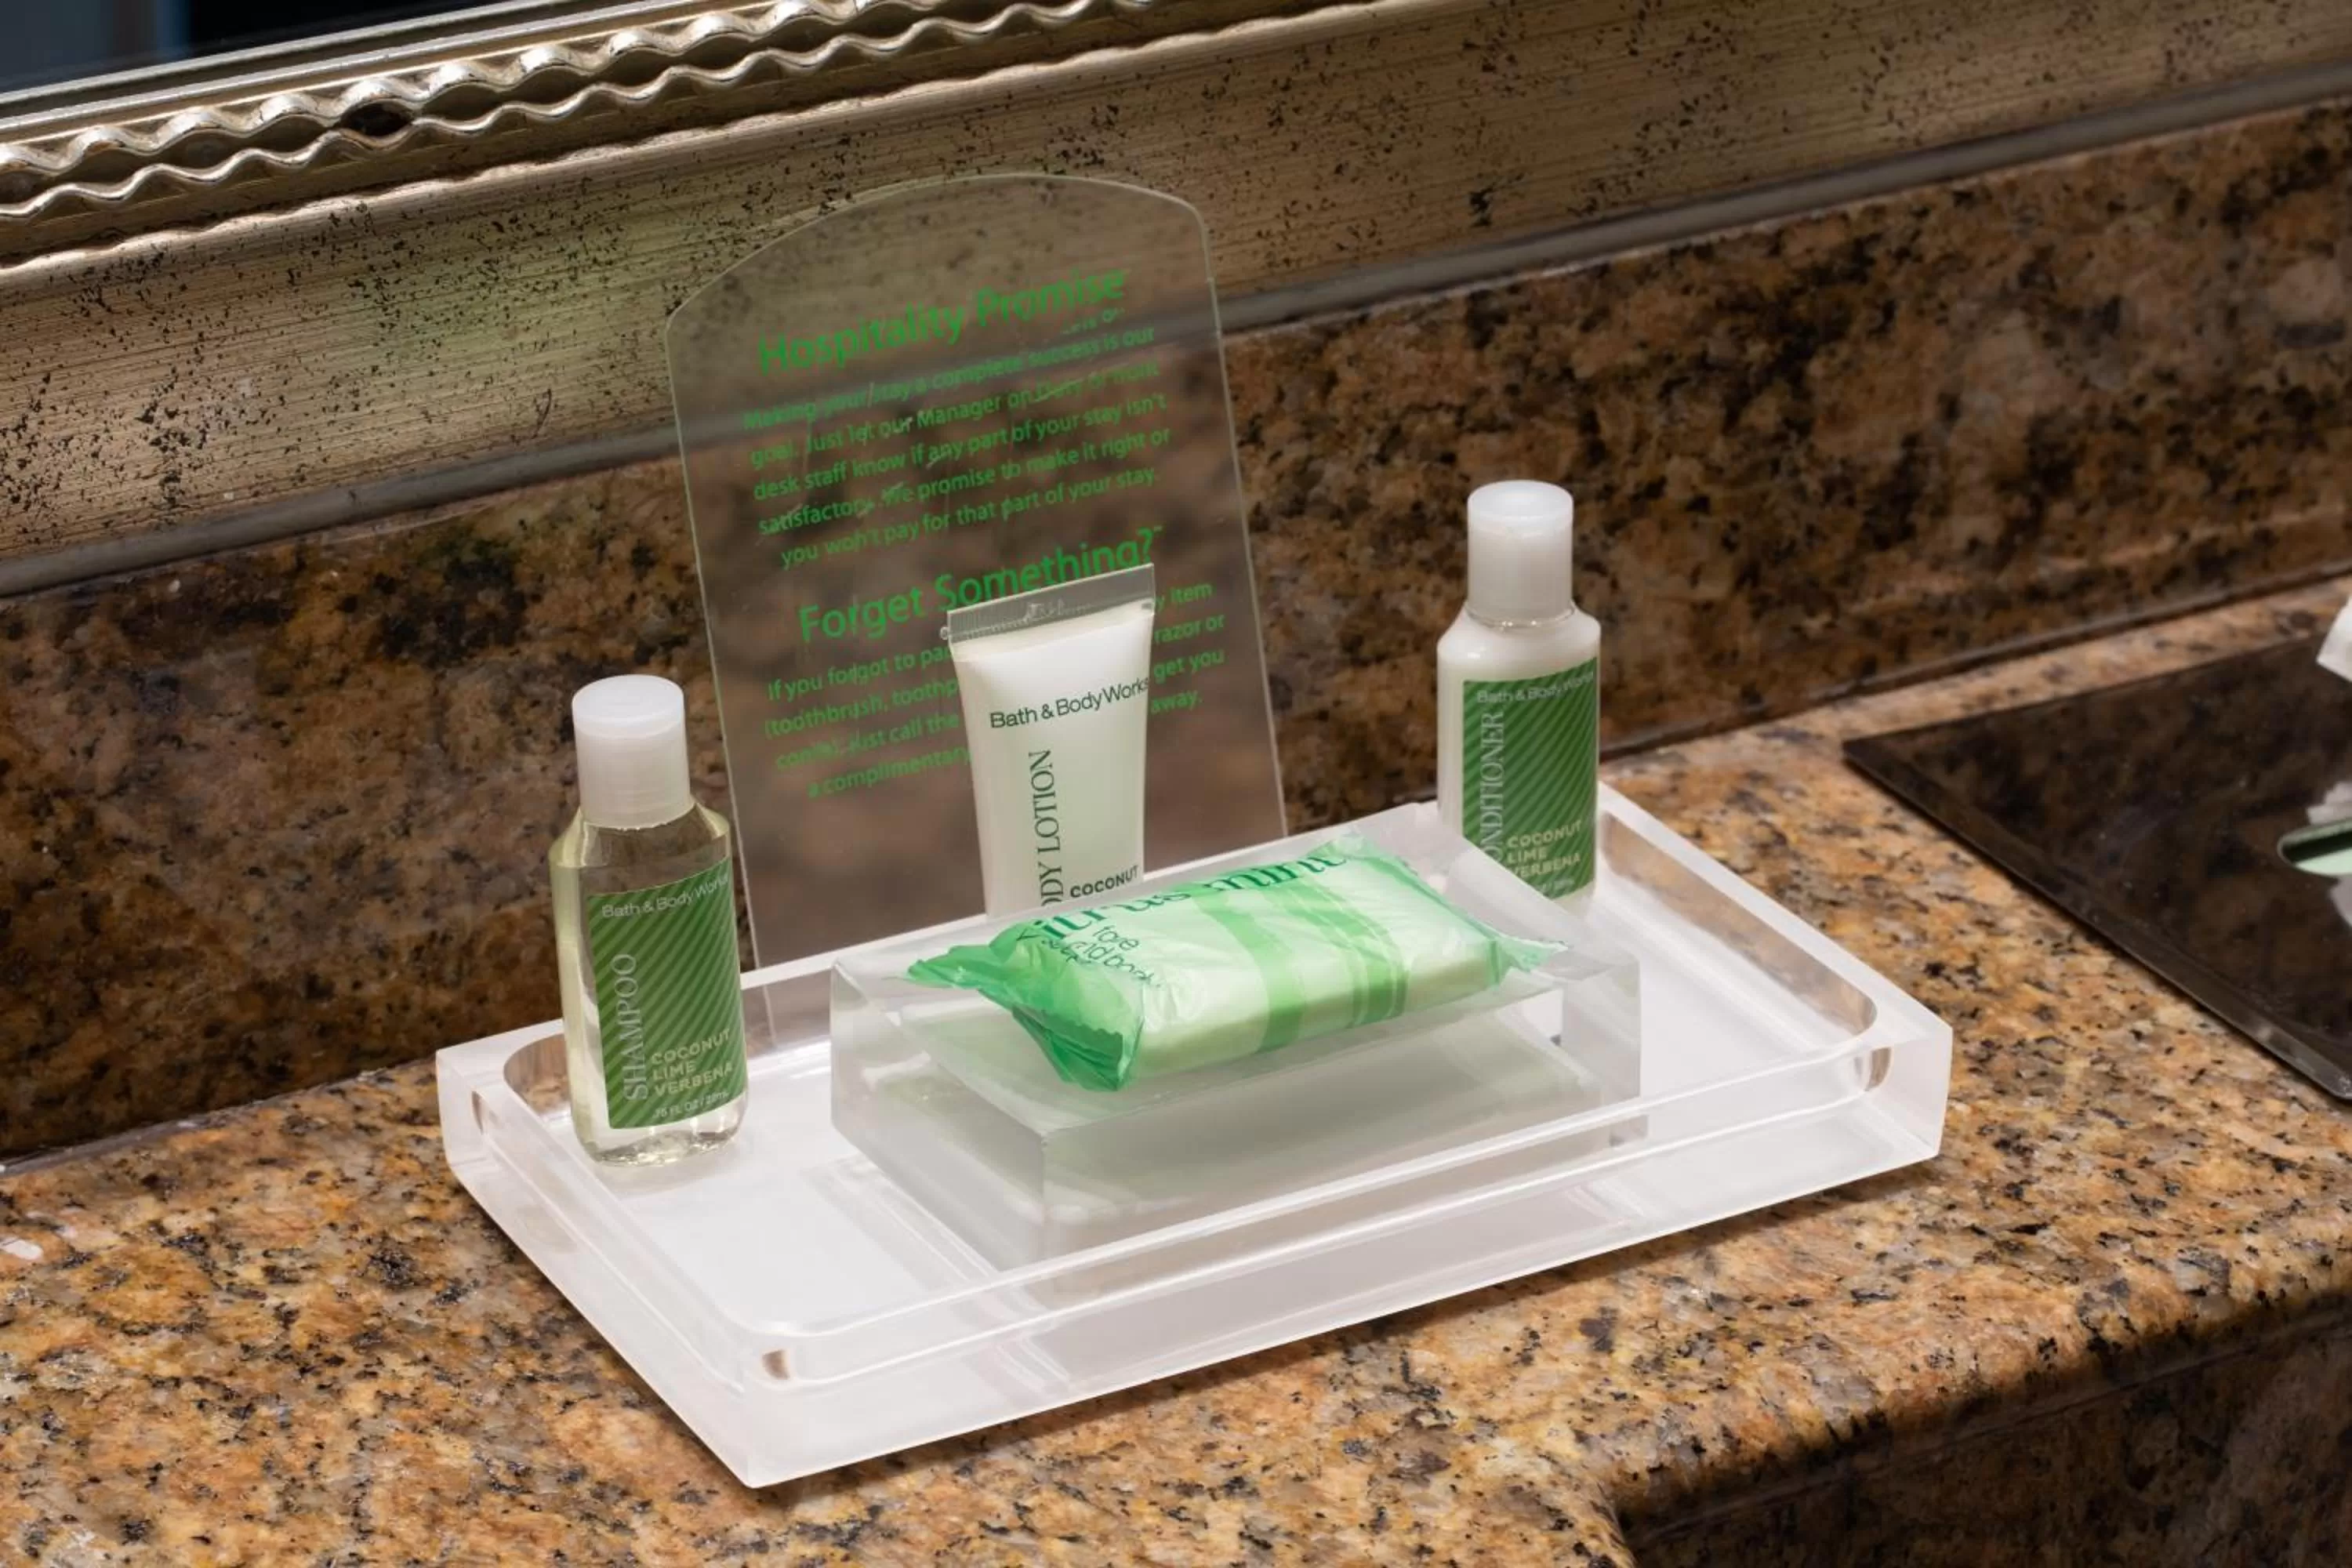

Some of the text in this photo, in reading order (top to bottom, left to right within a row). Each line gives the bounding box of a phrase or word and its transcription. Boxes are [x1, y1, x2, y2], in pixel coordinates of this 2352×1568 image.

[758, 301, 965, 376] Hospitality
[978, 267, 1126, 326] Promise
[1104, 332, 1119, 350] is
[1123, 328, 1155, 346] our
[848, 423, 875, 442] let
[879, 417, 913, 437] our
[916, 396, 1001, 429] Manager
[1007, 389, 1032, 408] on
[753, 394, 1167, 500] desk staff know if any part of your stay isn't
[917, 469, 996, 500] promise
[1001, 459, 1021, 480] to
[1027, 449, 1080, 472] make
[1083, 441, 1097, 461] it
[1102, 432, 1145, 459] right
[1150, 427, 1171, 445] or
[782, 545, 819, 571] you
[884, 521, 919, 546] pay
[922, 510, 950, 534] for
[956, 502, 996, 524] that
[1001, 491, 1040, 521] part
[1045, 482, 1064, 503] of
[1069, 476, 1112, 503] your
[799, 527, 1154, 642] Forget Something?
[767, 583, 1214, 703] If you forgot to pa item
[891, 677, 959, 706] toothp
[1154, 620, 1201, 645] razor
[1205, 614, 1226, 632] or
[889, 715, 924, 742] call
[927, 711, 960, 734] the
[1154, 657, 1185, 684] get
[1189, 648, 1225, 673] you
[990, 677, 1149, 729] Bath & Body Works
[1477, 689, 1514, 703] Bath
[1515, 688, 1526, 701] &
[823, 746, 971, 796] complimentary
[1479, 710, 1504, 862] ONDITIONER
[1029, 748, 1062, 855] LOTION
[1507, 819, 1582, 848] COCONUT
[1507, 847, 1548, 863] LIME
[601, 873, 729, 918] Bath & Body Works
[1070, 865, 1140, 898] COCONUT
[609, 953, 649, 1102] SHAMPOO
[652, 1028, 731, 1065] COCONUT
[652, 1059, 697, 1082] LIME
[655, 1062, 735, 1097] VERBENA
